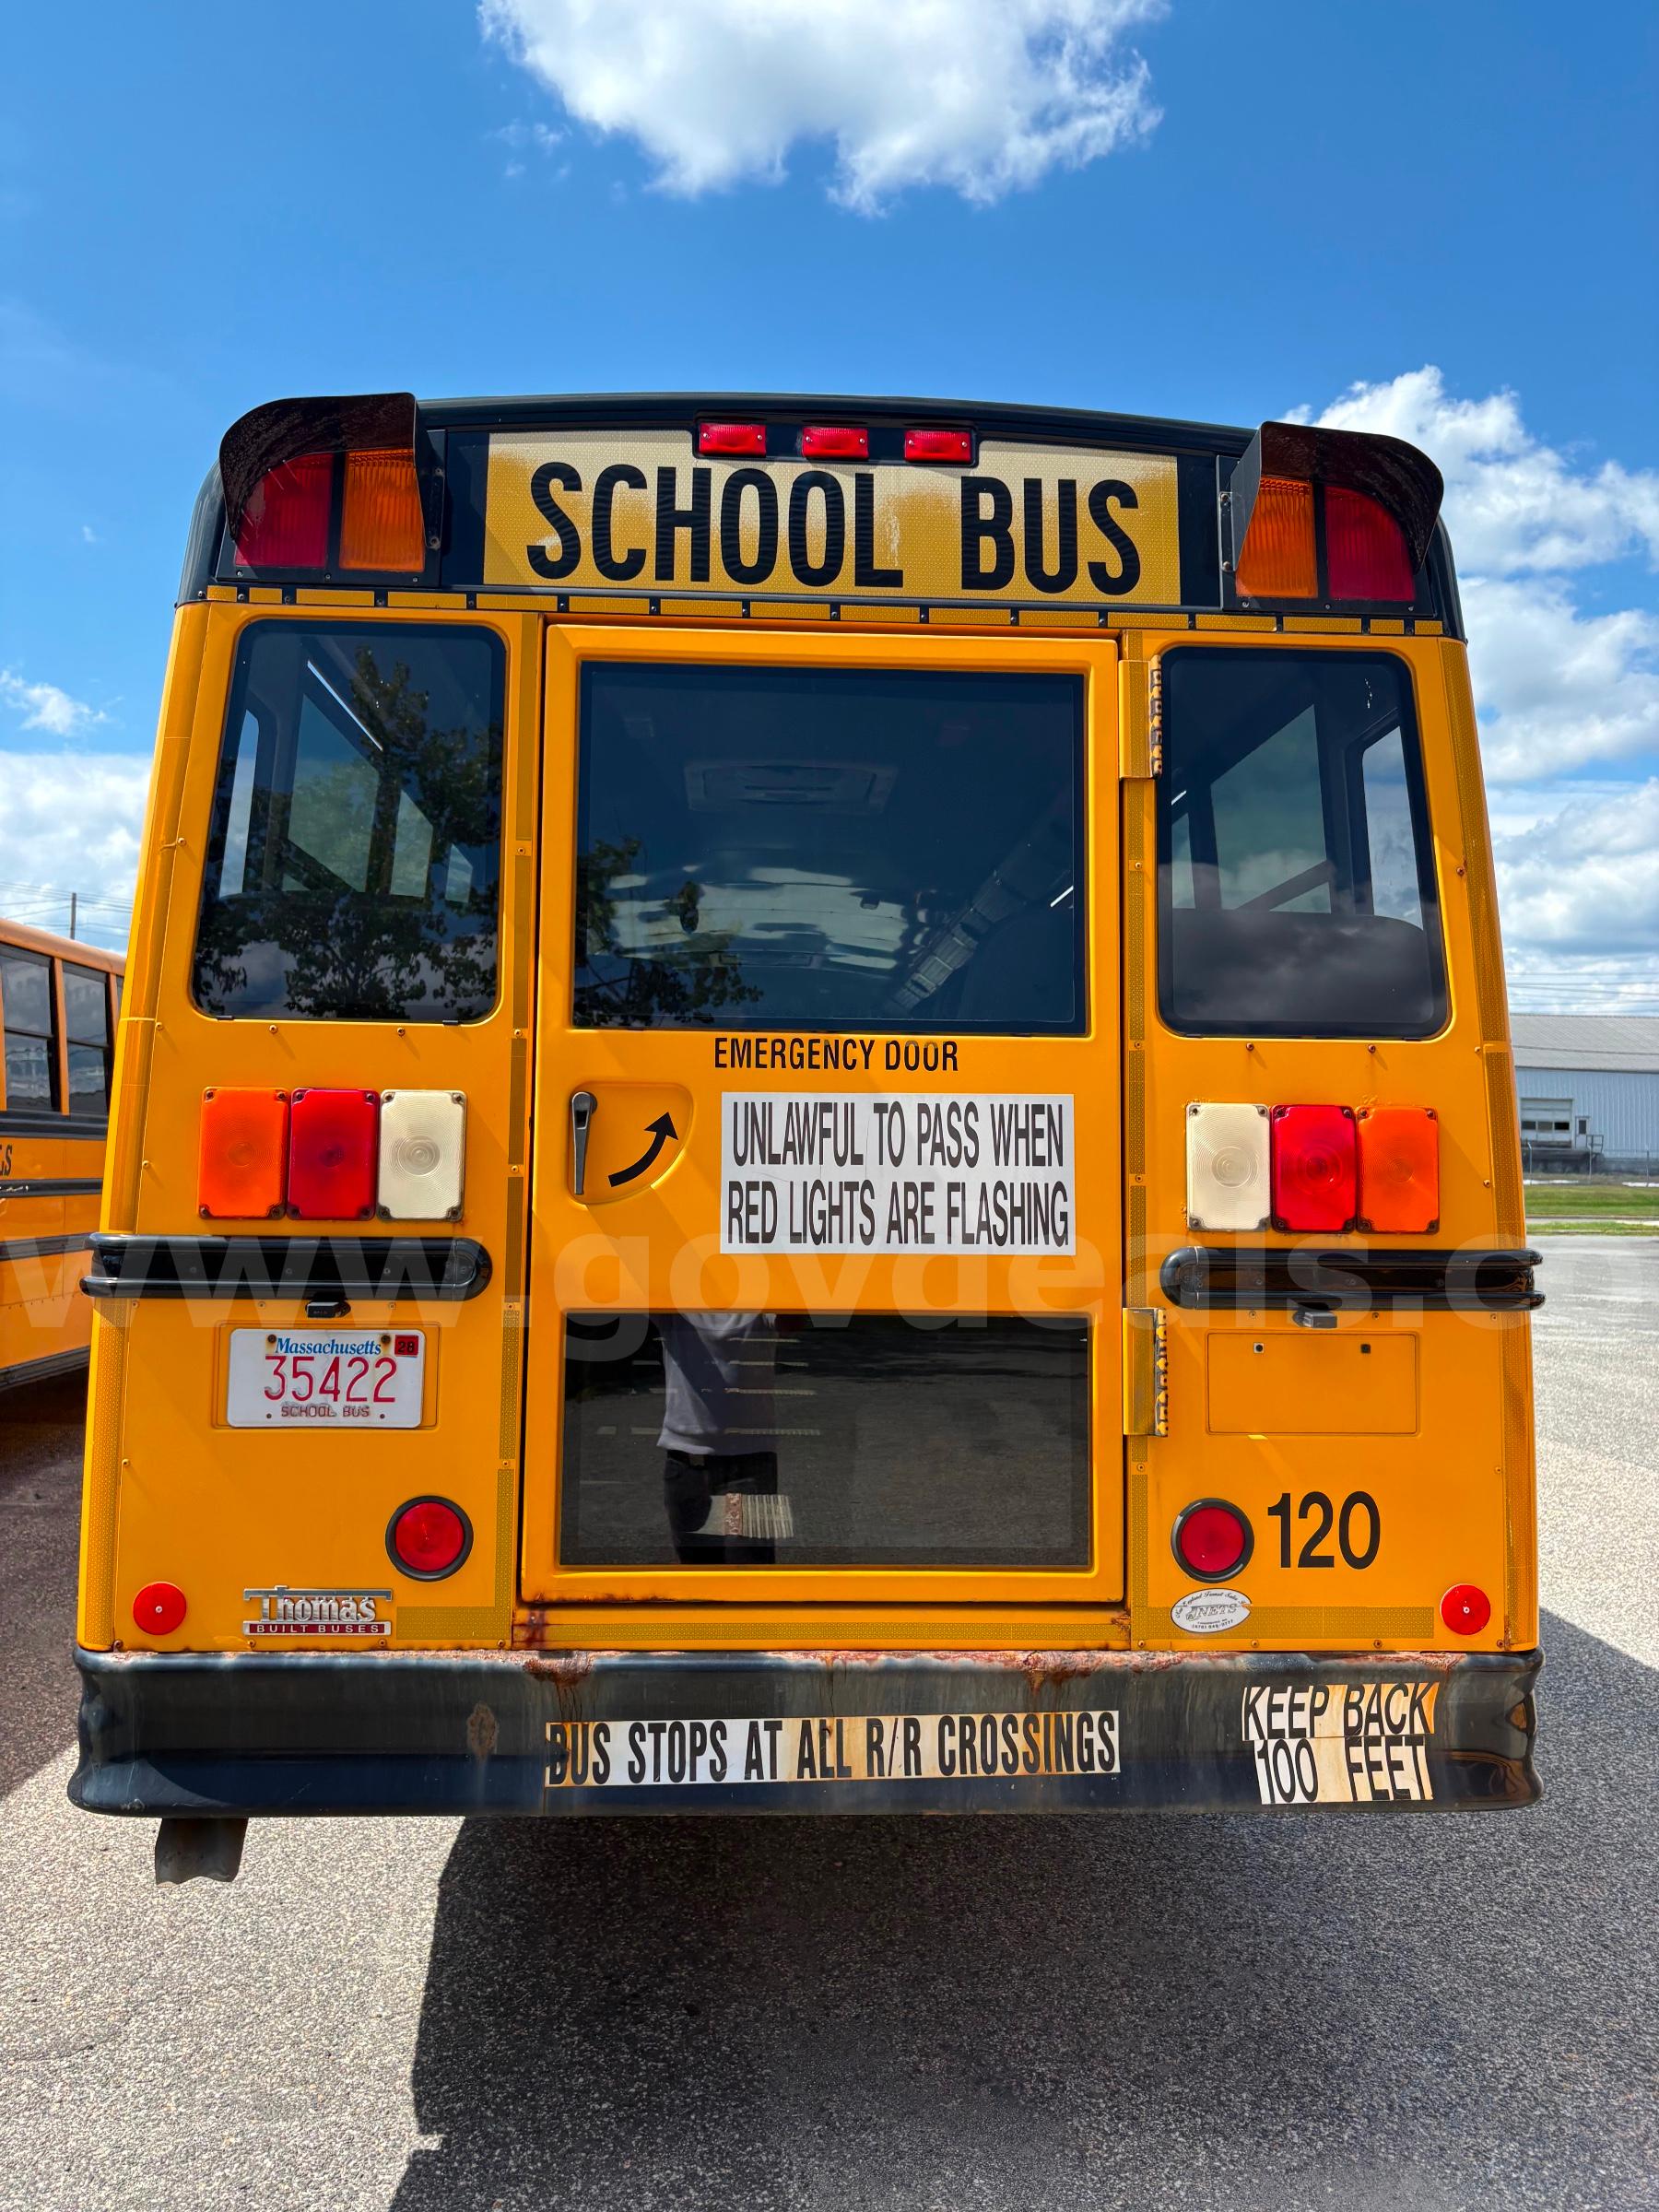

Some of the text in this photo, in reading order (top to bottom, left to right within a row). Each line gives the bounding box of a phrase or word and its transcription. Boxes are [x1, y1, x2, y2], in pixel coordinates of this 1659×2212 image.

[525, 462, 1141, 595] SCHOOL BUS
[713, 1038, 959, 1072] EMERGENCY DOOR
[733, 1100, 1064, 1169] UNLAWFUL TO PASS WHEN
[727, 1179, 1069, 1247] RED LIGHTS ARE FLASHING
[275, 1337, 382, 1356] Massachusetts
[264, 1355, 397, 1403] 35422
[281, 1405, 371, 1418] SCHOOL BUS
[1267, 1490, 1381, 1570] 120
[243, 1585, 393, 1622] Thomas
[256, 1624, 380, 1633] BUILT BUSES
[1244, 1682, 1438, 1740] KEEP BACK
[549, 1712, 1116, 1785] BUS STOPS AT ALL R/R CROSSINGS
[1255, 1735, 1430, 1804] 100 FEET
